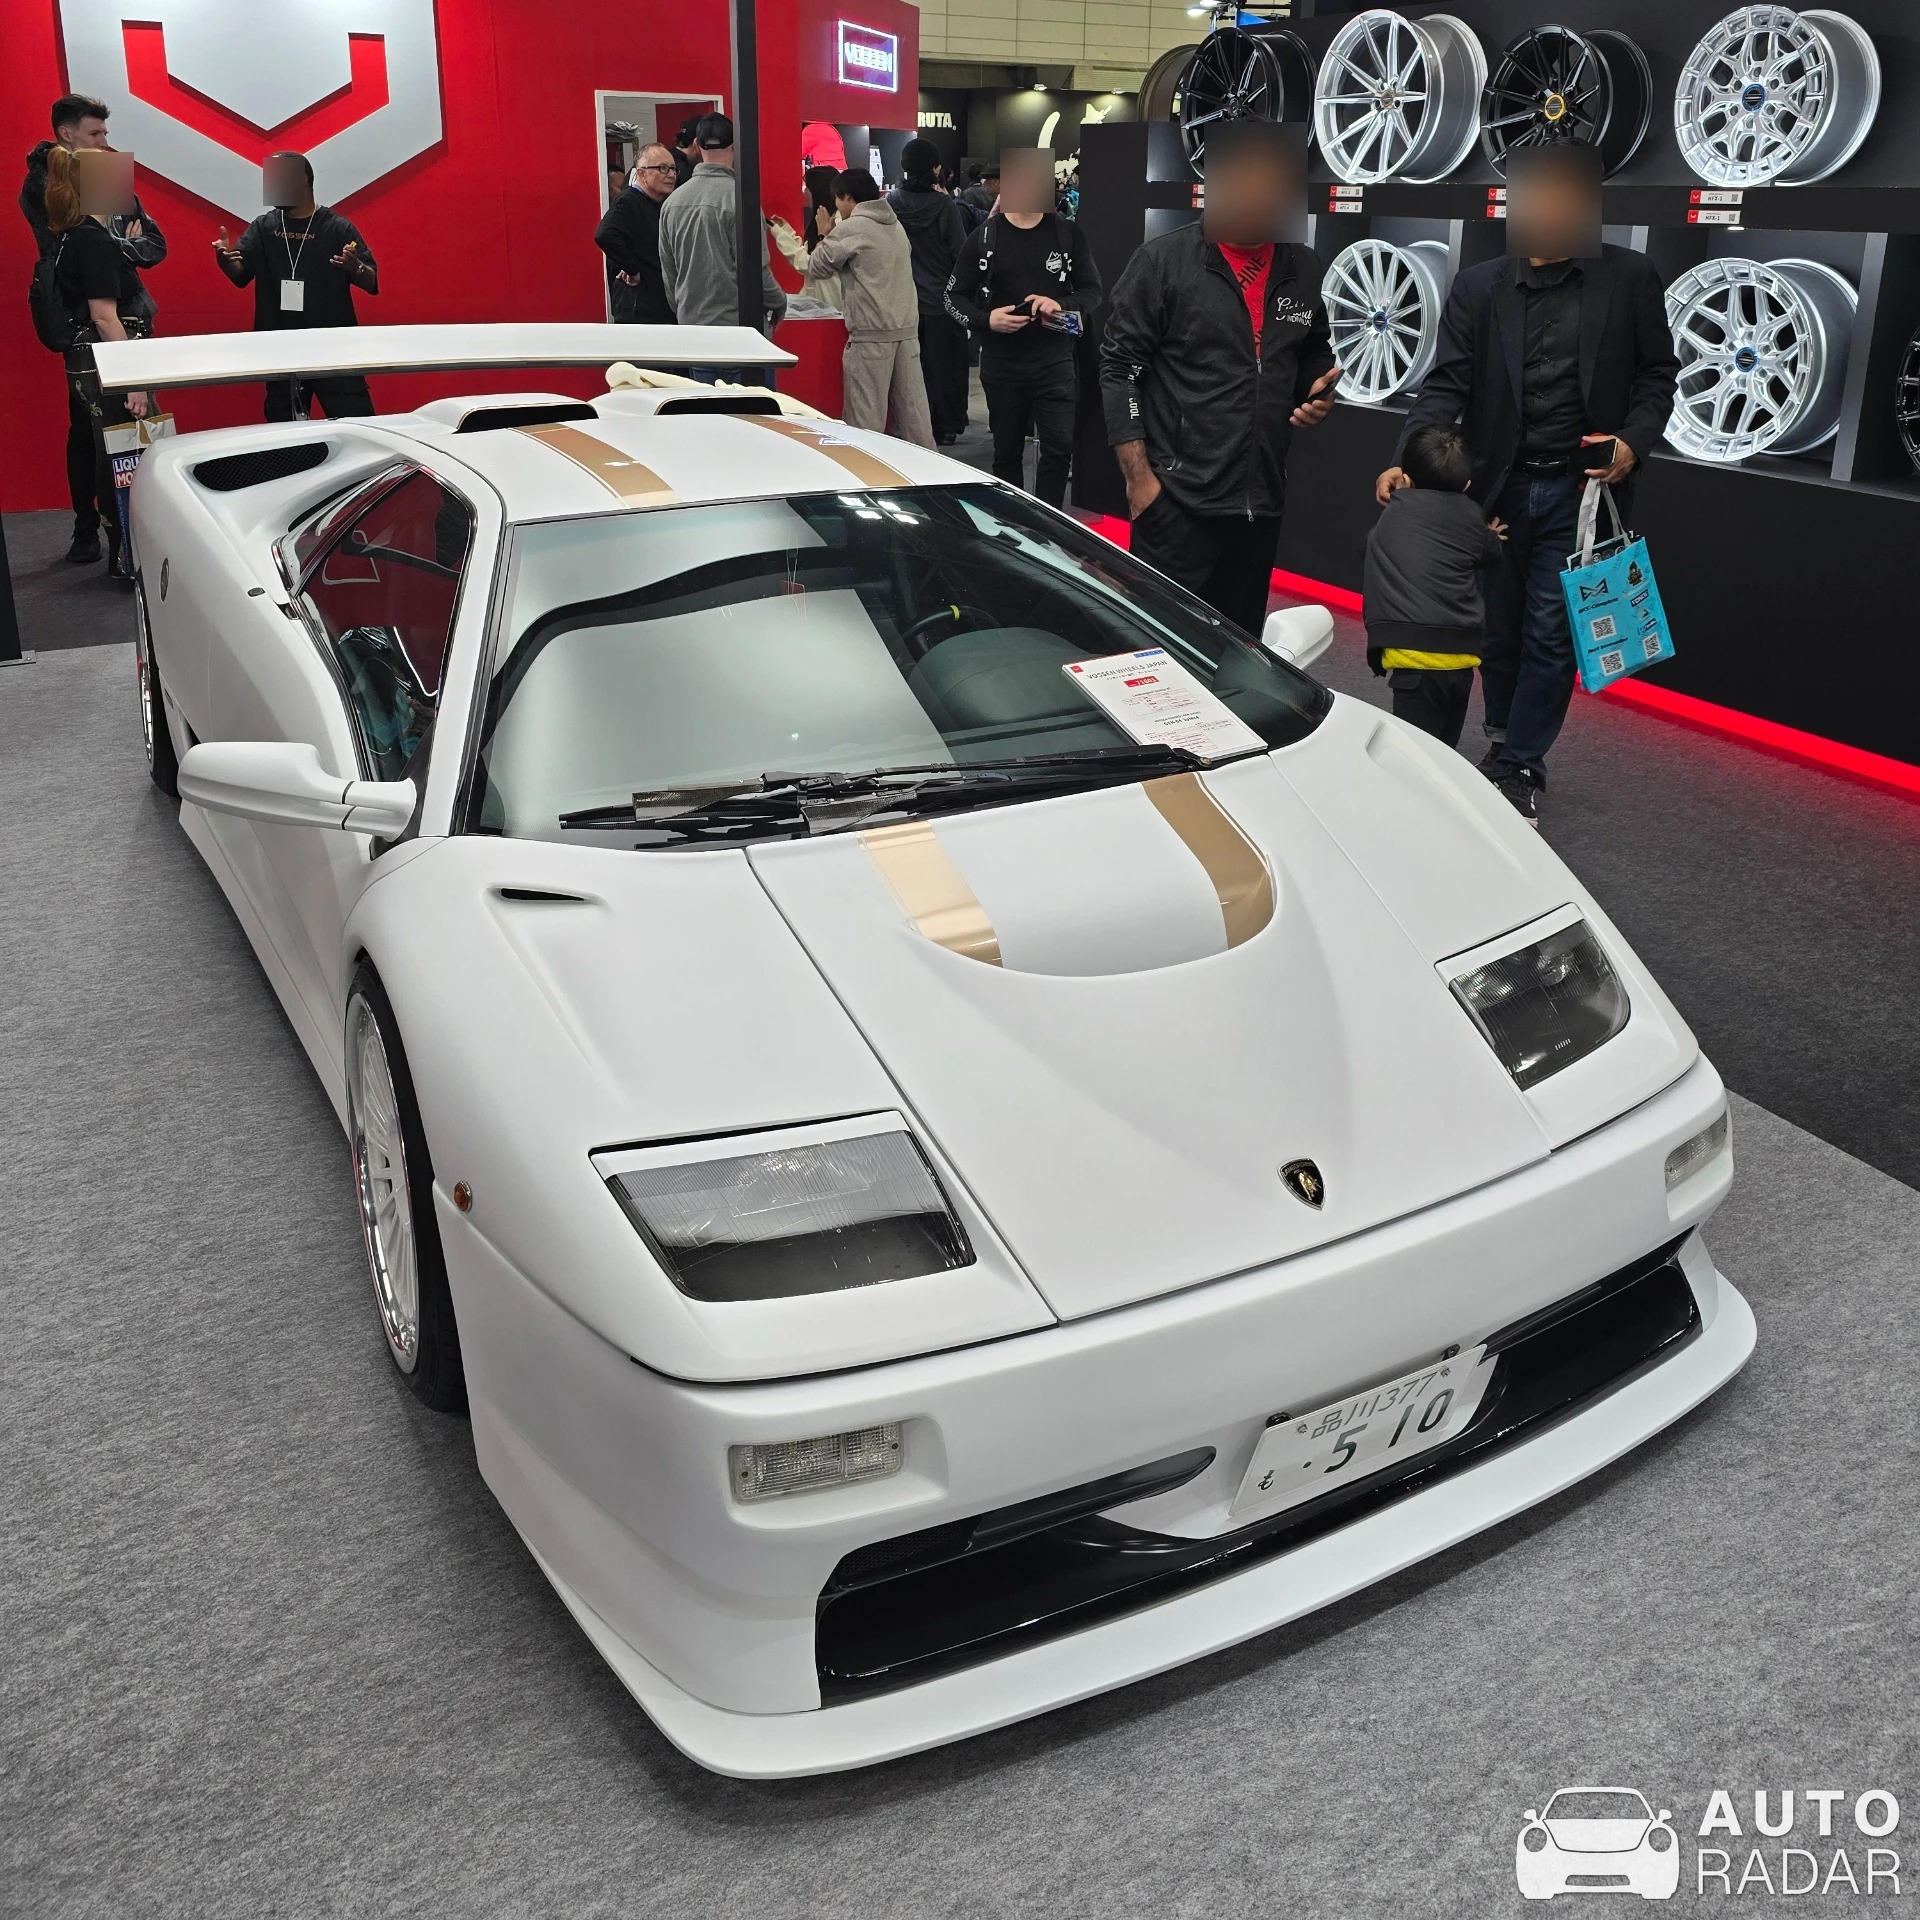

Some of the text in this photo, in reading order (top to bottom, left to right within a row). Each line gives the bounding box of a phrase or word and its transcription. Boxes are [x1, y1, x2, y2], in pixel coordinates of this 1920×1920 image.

[114, 456, 139, 472] LIQU
[1086, 670, 1116, 680] VOSSEN
[1117, 664, 1146, 673] WHEELS
[1145, 660, 1168, 668] JAPAN
